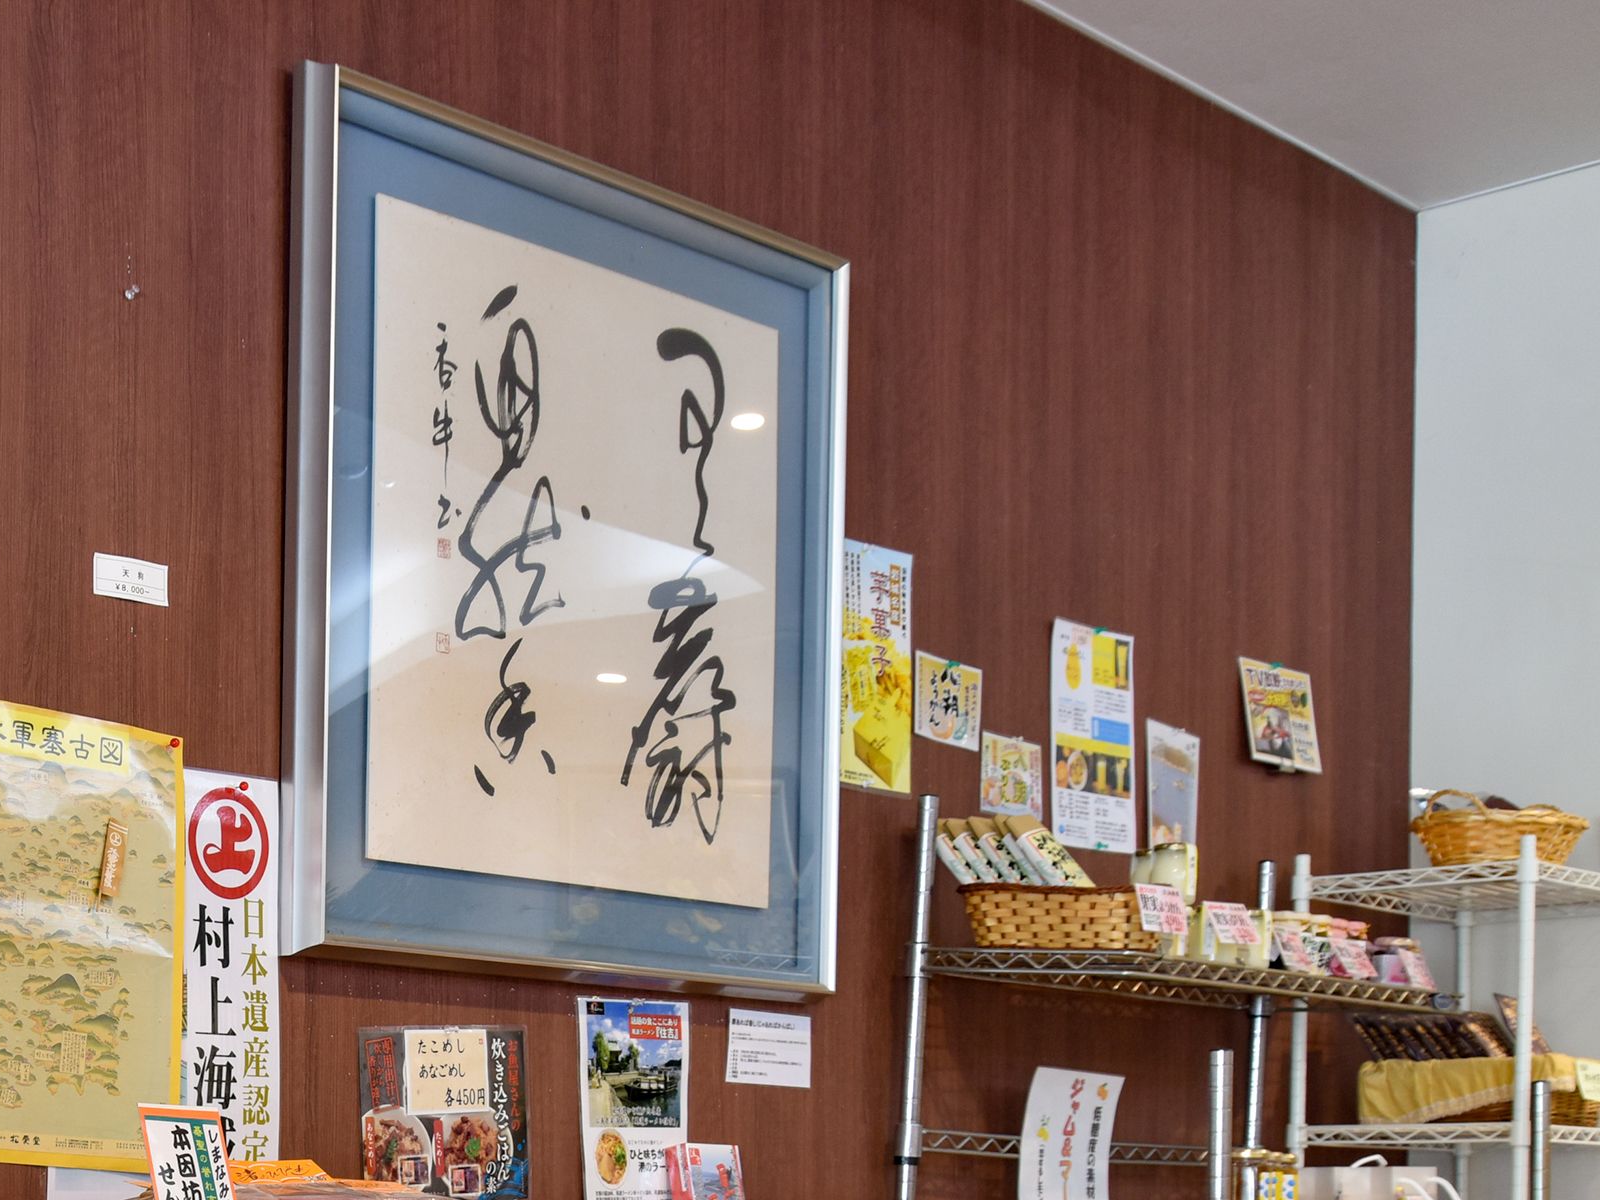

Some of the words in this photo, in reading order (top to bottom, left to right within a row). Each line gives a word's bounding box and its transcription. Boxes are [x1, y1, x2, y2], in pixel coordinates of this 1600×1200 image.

[240, 897, 271, 1162] 日本遺産認定
[417, 1038, 465, 1055] たこめし
[418, 1063, 467, 1080] あなごめし
[507, 1039, 521, 1131] お魚屋さんの
[444, 1086, 486, 1108] 各450円
[490, 1037, 512, 1183] 炊き込みごはん
[485, 1160, 497, 1194] の素
